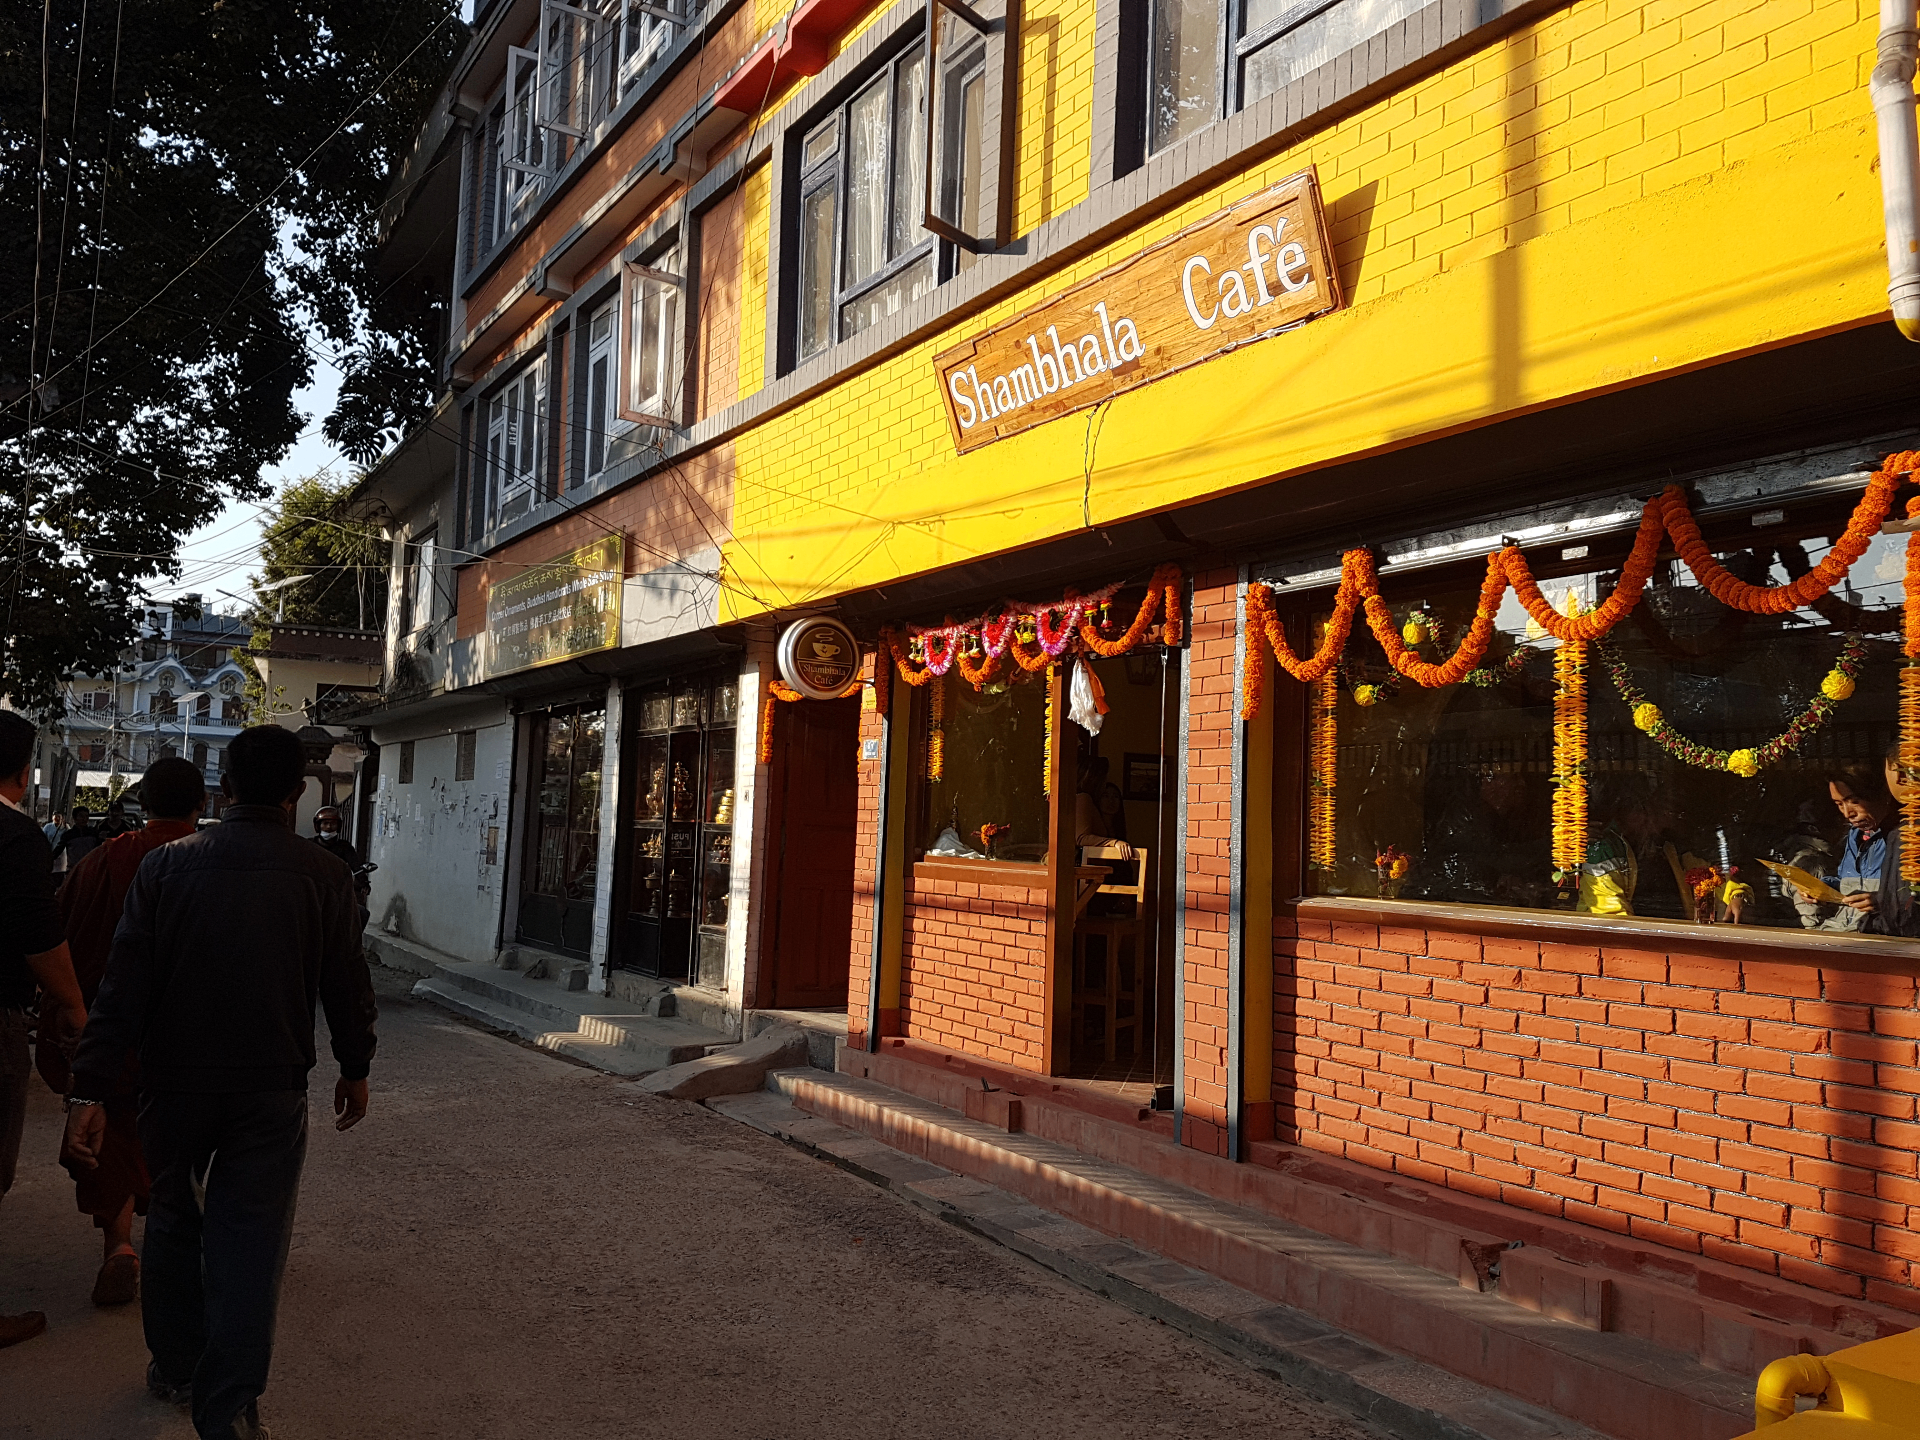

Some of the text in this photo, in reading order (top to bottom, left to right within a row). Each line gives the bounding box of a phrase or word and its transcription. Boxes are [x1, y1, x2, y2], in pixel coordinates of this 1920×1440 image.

[949, 217, 1311, 430] Shambhala Café
[491, 609, 505, 623] Copper
[527, 592, 546, 609] Buddhist
[545, 582, 571, 603] Handicrafts
[571, 577, 587, 593] Whole
[803, 663, 846, 676] Shambhala
[814, 675, 834, 685] Café
